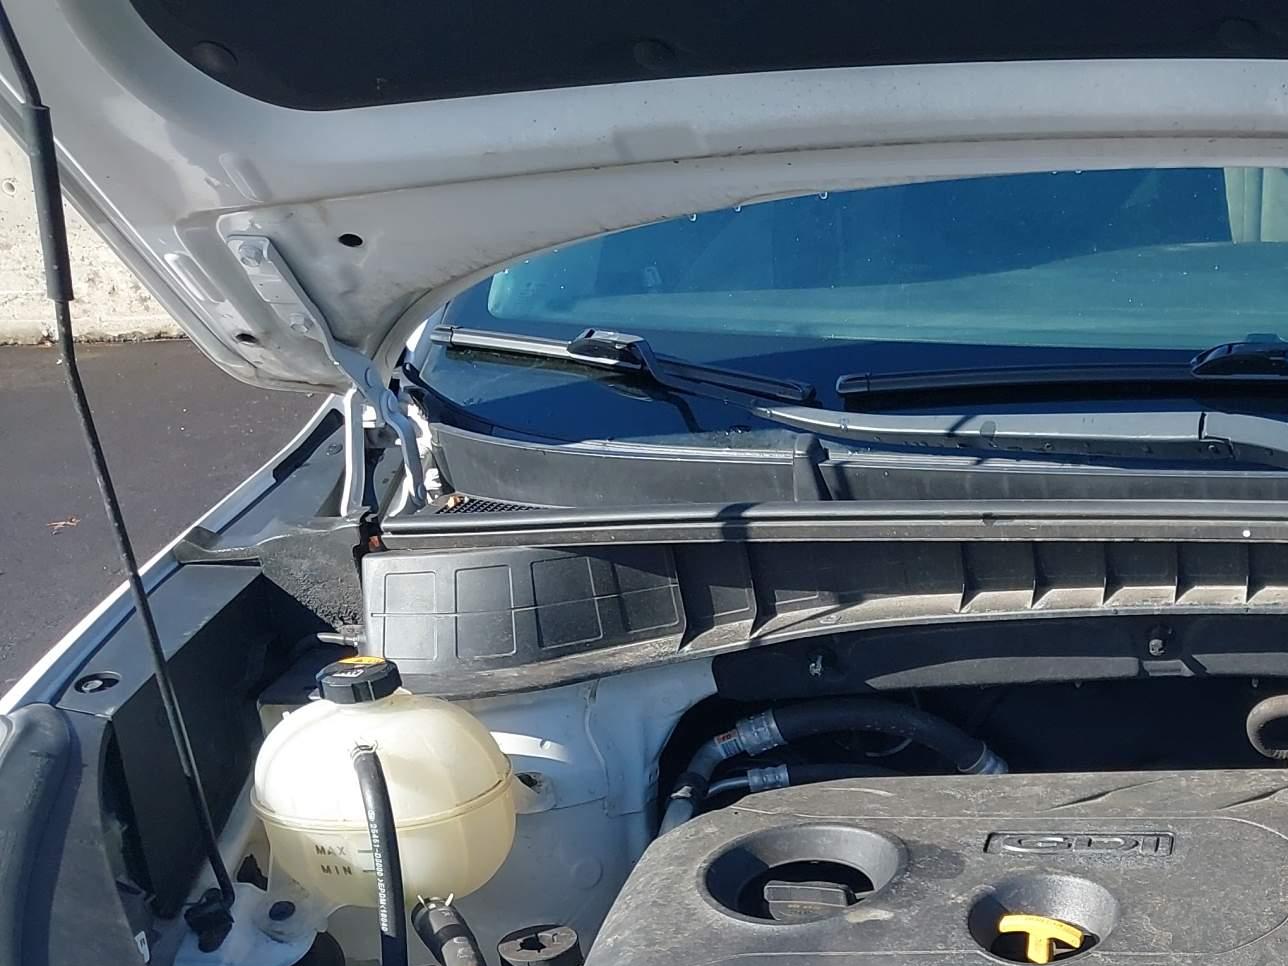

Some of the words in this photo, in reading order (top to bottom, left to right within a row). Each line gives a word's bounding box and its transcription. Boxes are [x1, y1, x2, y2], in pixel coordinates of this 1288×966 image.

[1001, 834, 1164, 853] GDI
[315, 844, 347, 856] MAX
[320, 864, 353, 876] MIN
